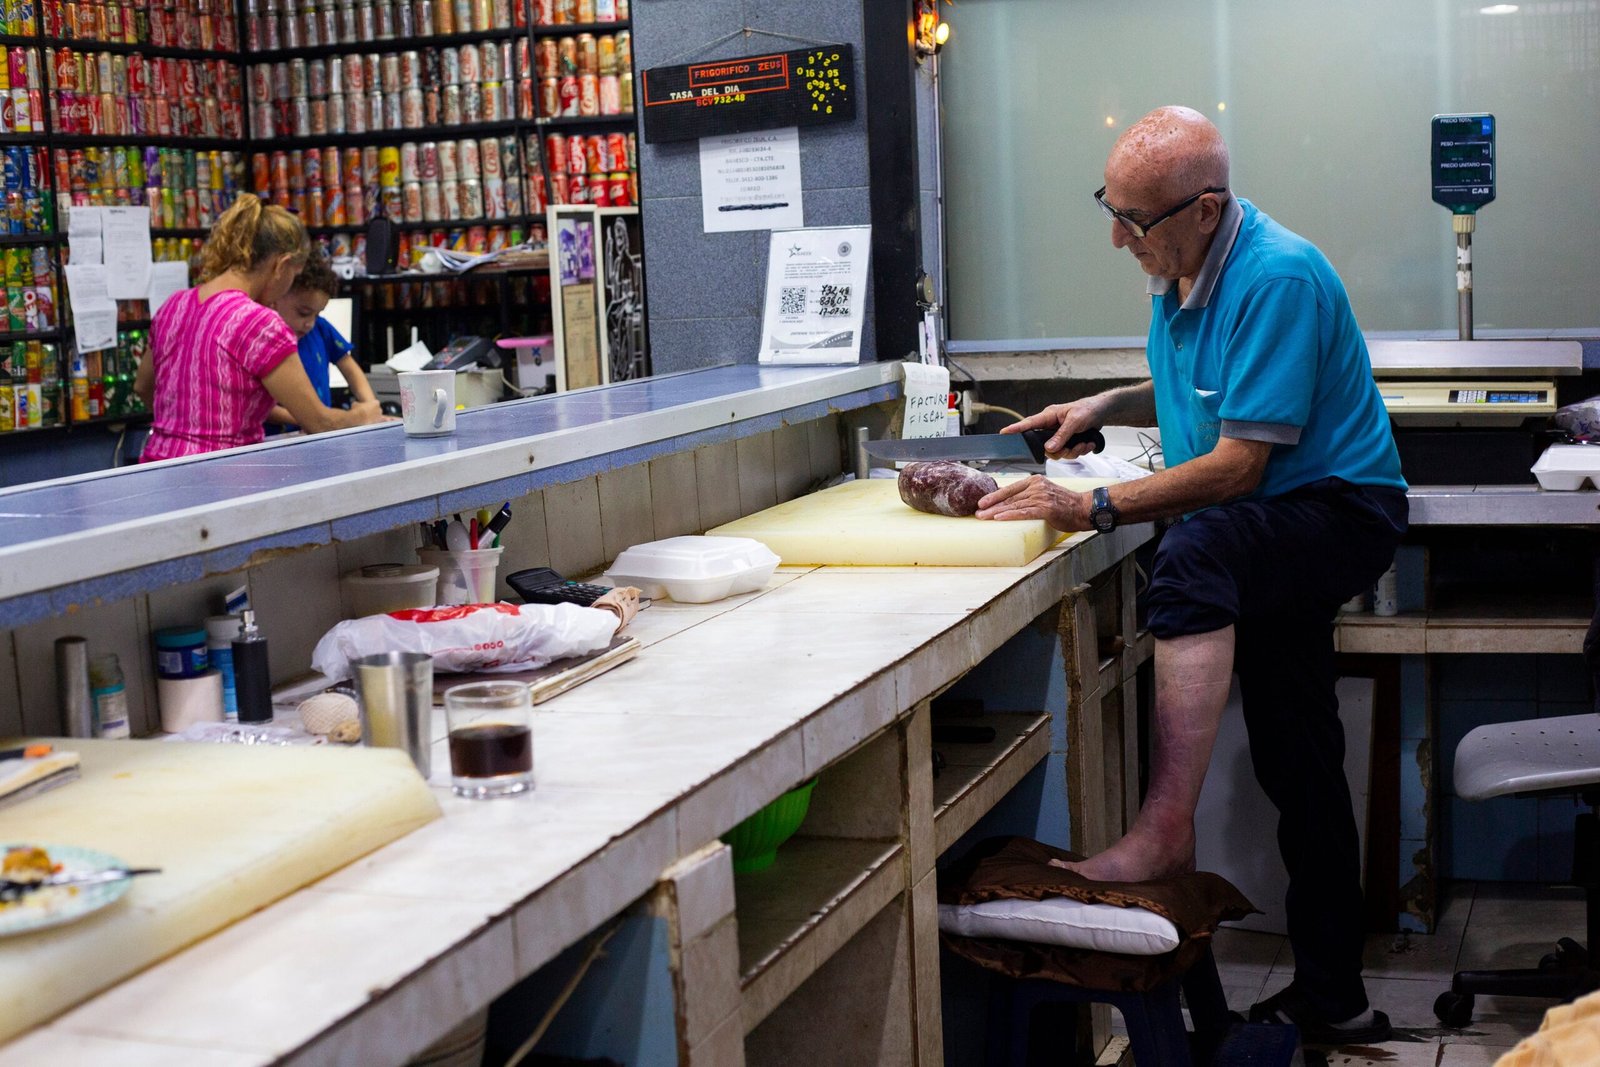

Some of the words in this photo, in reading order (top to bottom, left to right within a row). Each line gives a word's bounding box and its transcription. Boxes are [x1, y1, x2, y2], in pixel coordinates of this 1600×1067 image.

[694, 65, 750, 79] FRIGORIFICO
[758, 60, 781, 71] ZEUS
[670, 90, 693, 100] TASA
[701, 87, 719, 97] DEL
[724, 85, 740, 94] DIA
